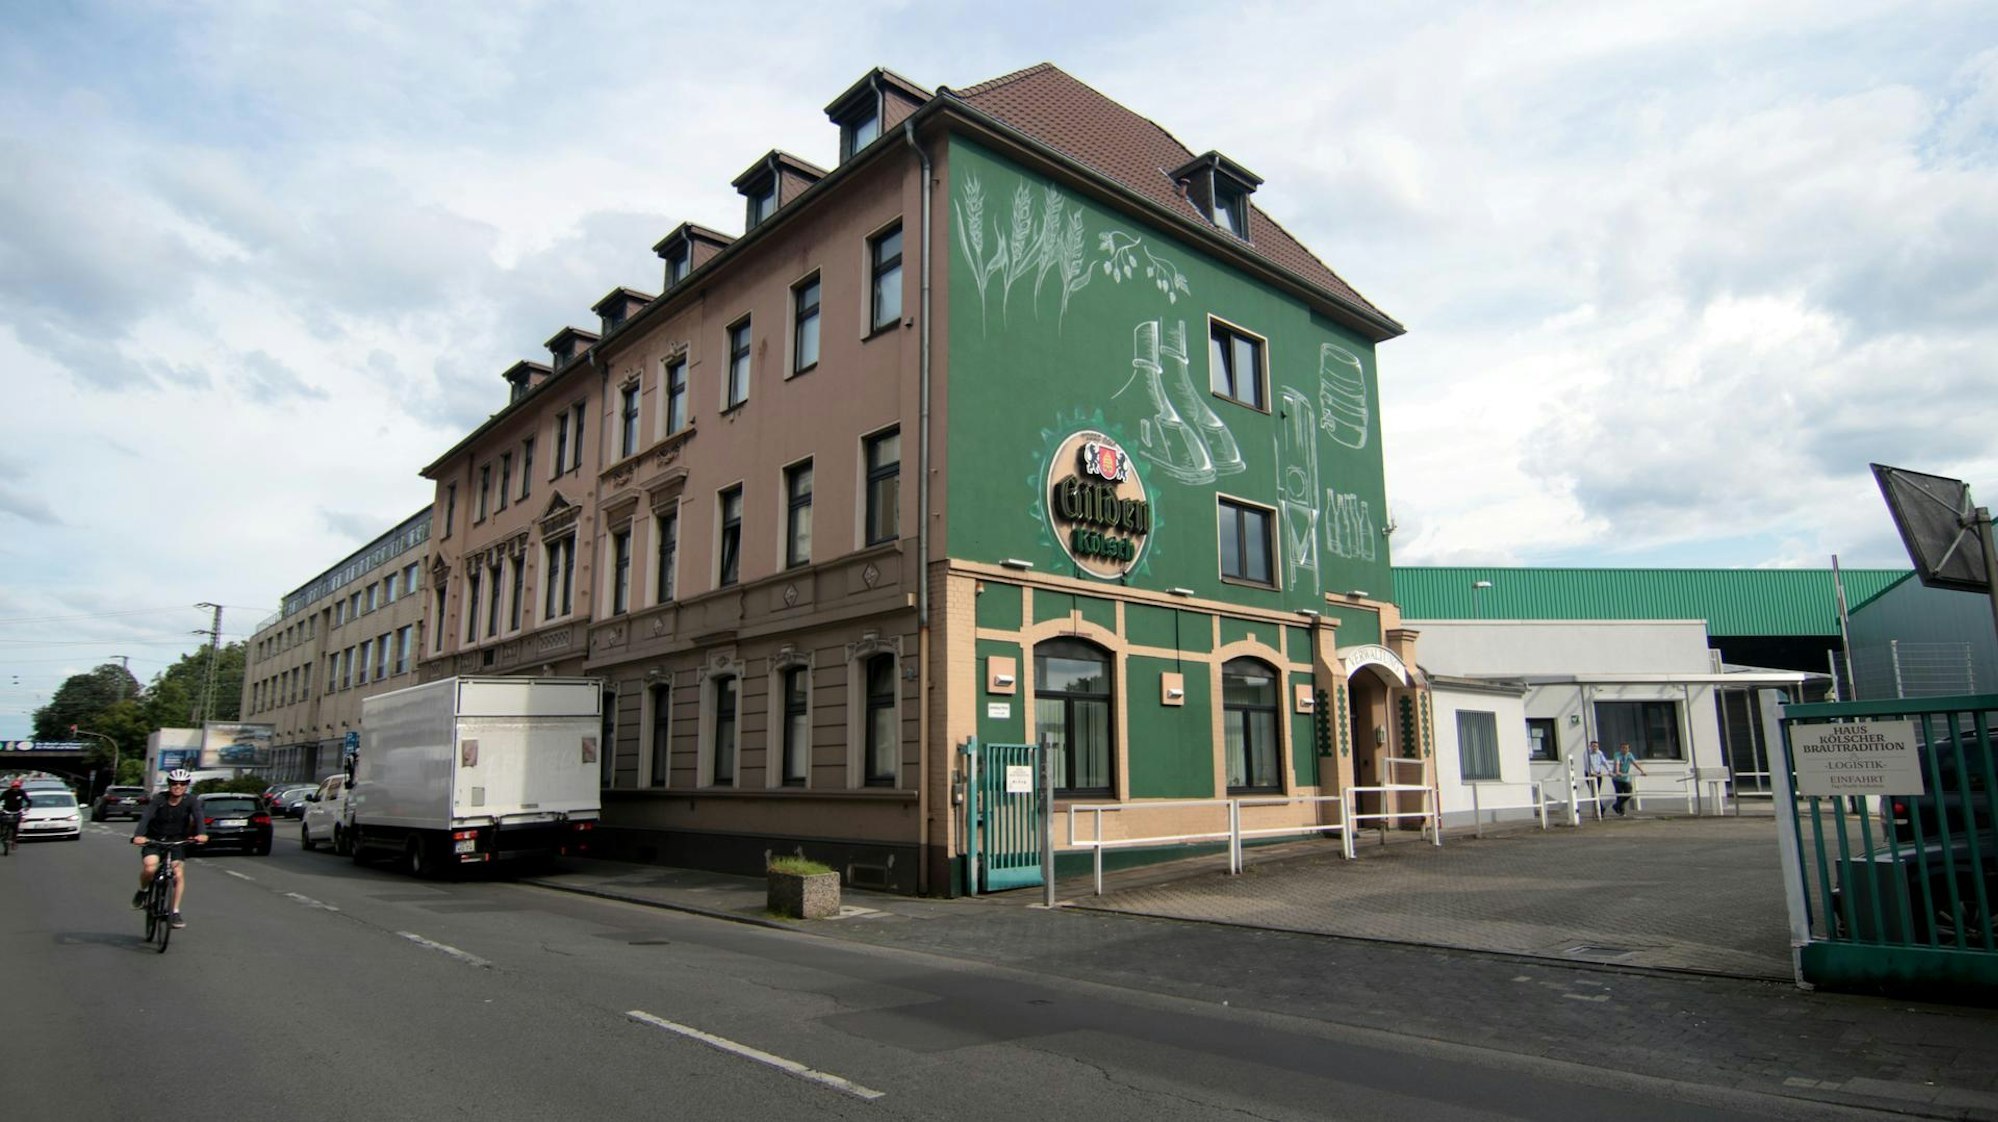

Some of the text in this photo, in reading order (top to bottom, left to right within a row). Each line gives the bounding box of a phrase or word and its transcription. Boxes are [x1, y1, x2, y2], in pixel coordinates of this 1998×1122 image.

[1054, 474, 1149, 535] Gilden
[1832, 725, 1868, 735] HAUS
[1819, 733, 1886, 744] KÖLSCHER
[1803, 742, 1905, 753] BRAUTRADITION
[1830, 774, 1884, 784] EINFAHRT
